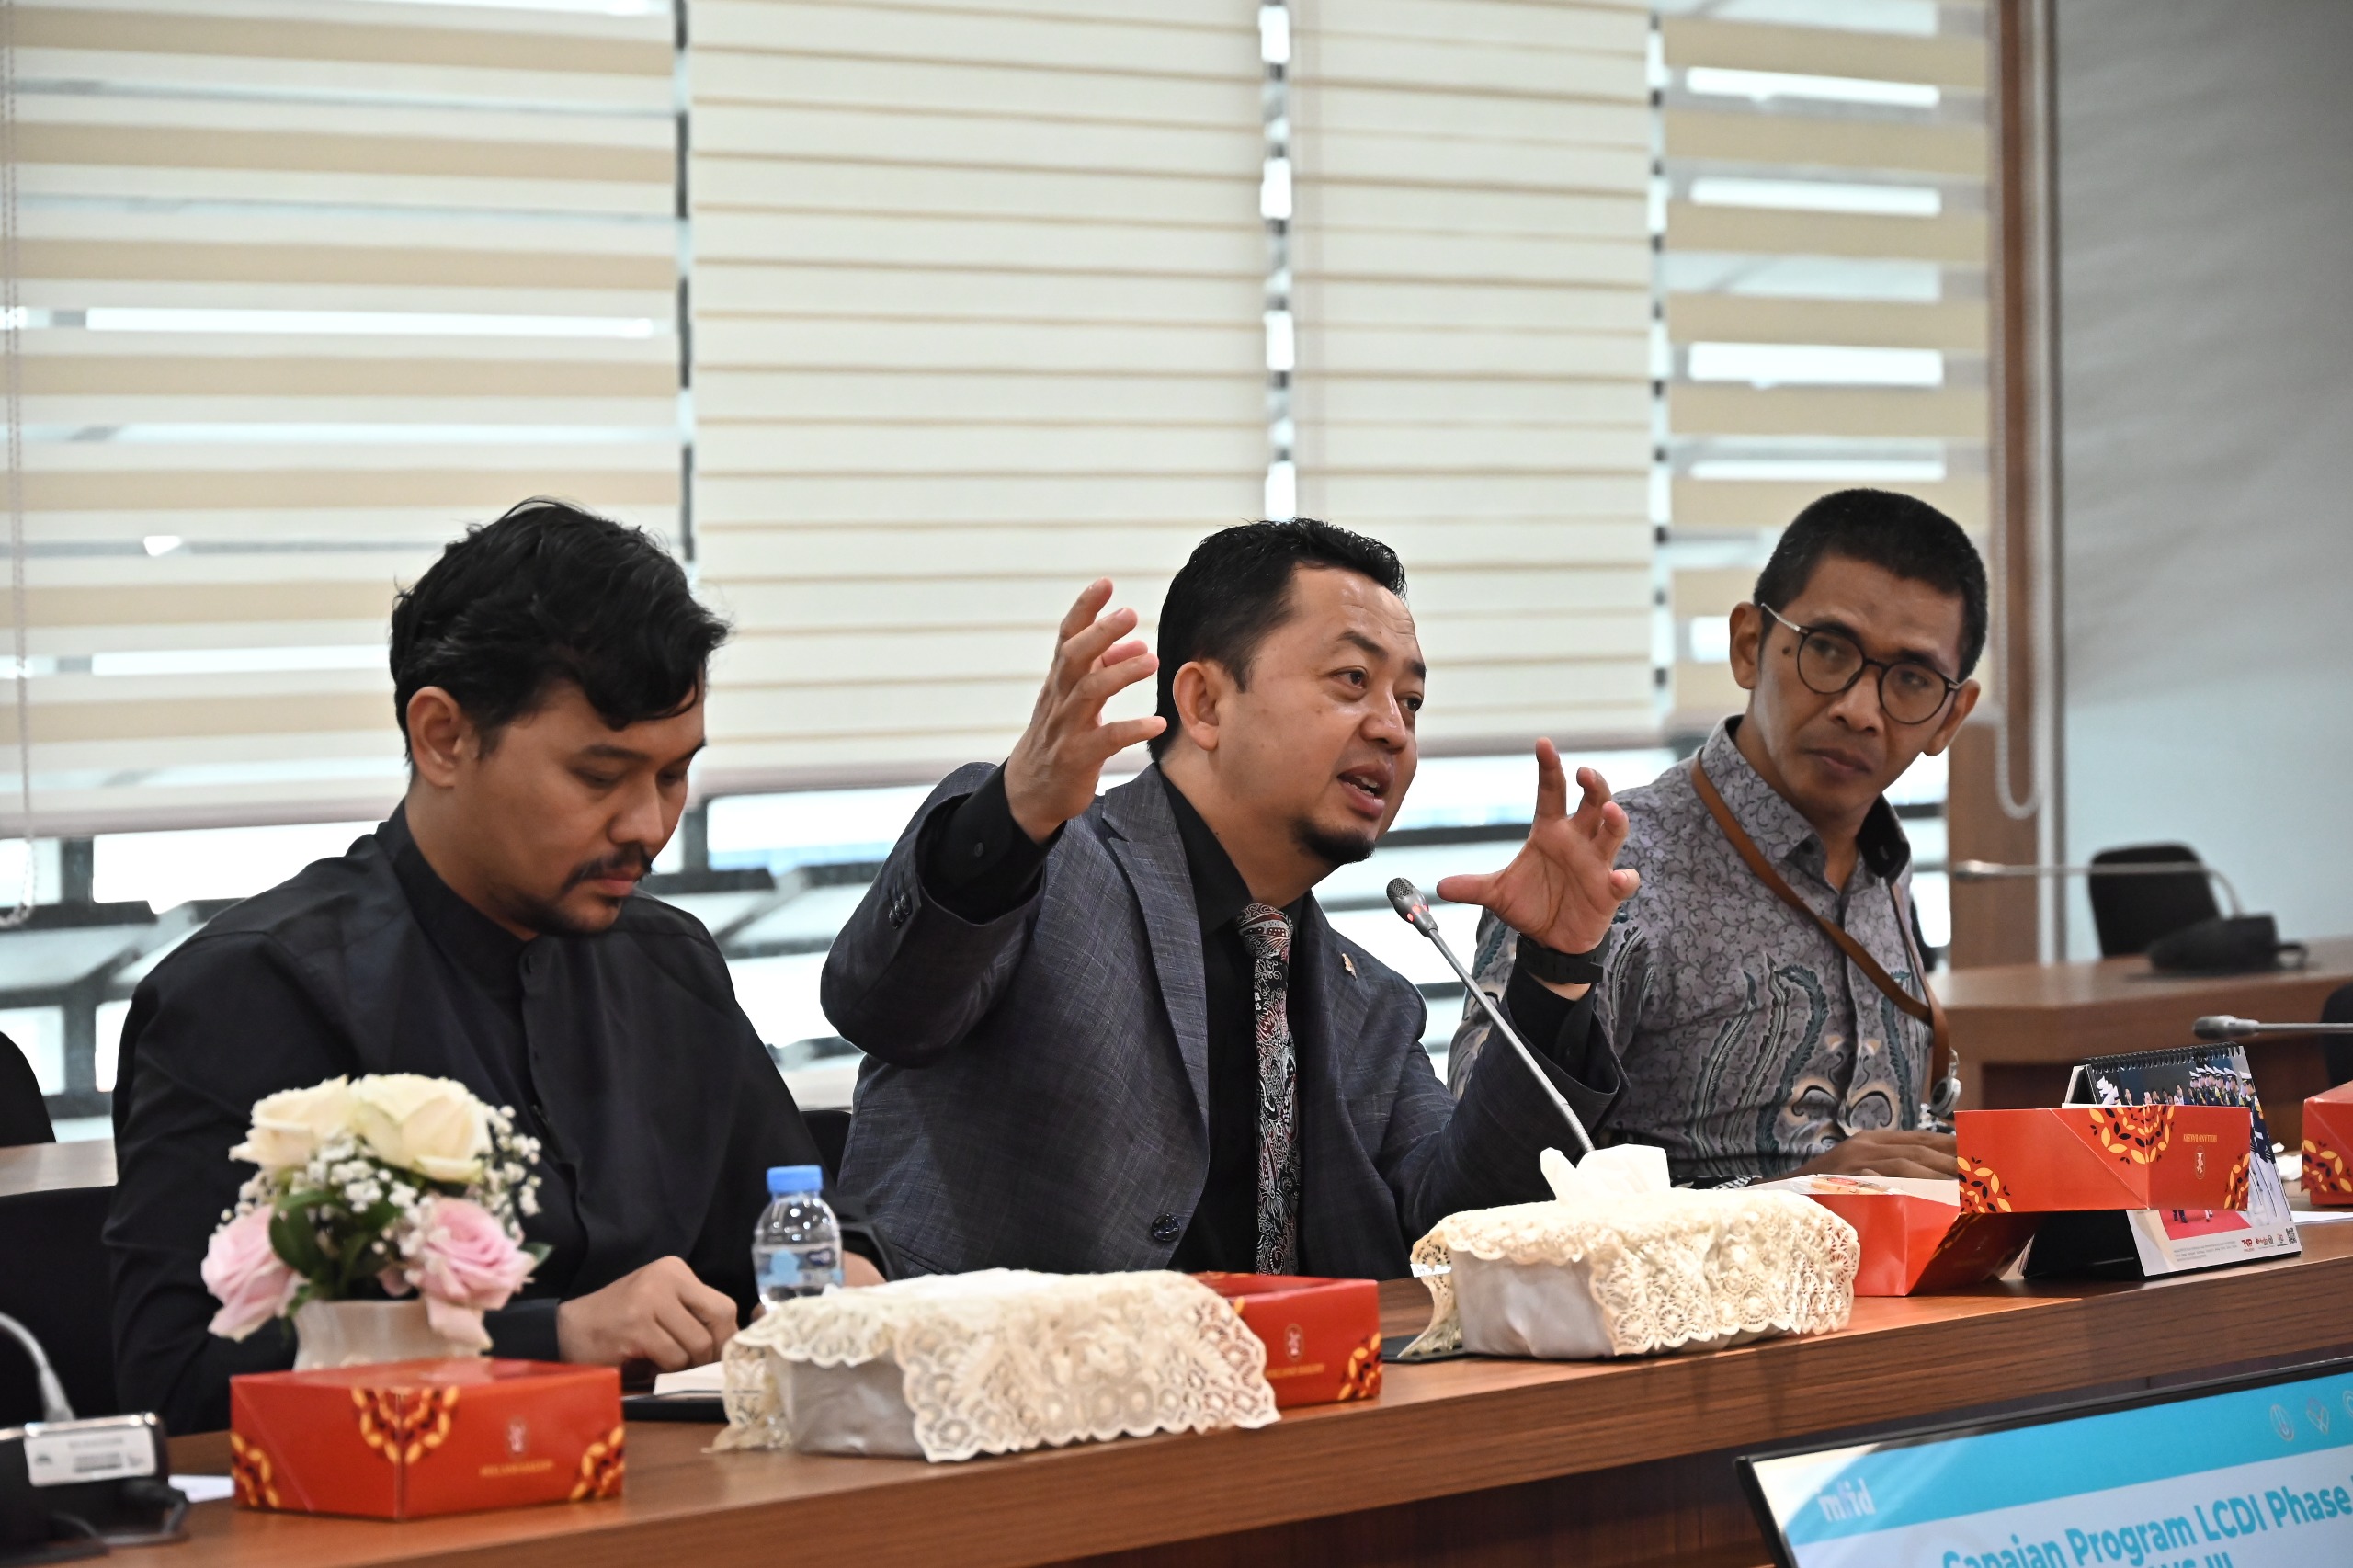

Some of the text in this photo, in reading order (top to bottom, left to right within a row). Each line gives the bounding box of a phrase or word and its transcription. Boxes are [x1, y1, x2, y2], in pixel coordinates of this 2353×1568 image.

[2065, 1516, 2198, 1567] Program
[2193, 1494, 2268, 1541] LCDI
[2264, 1486, 2353, 1528] Phase
